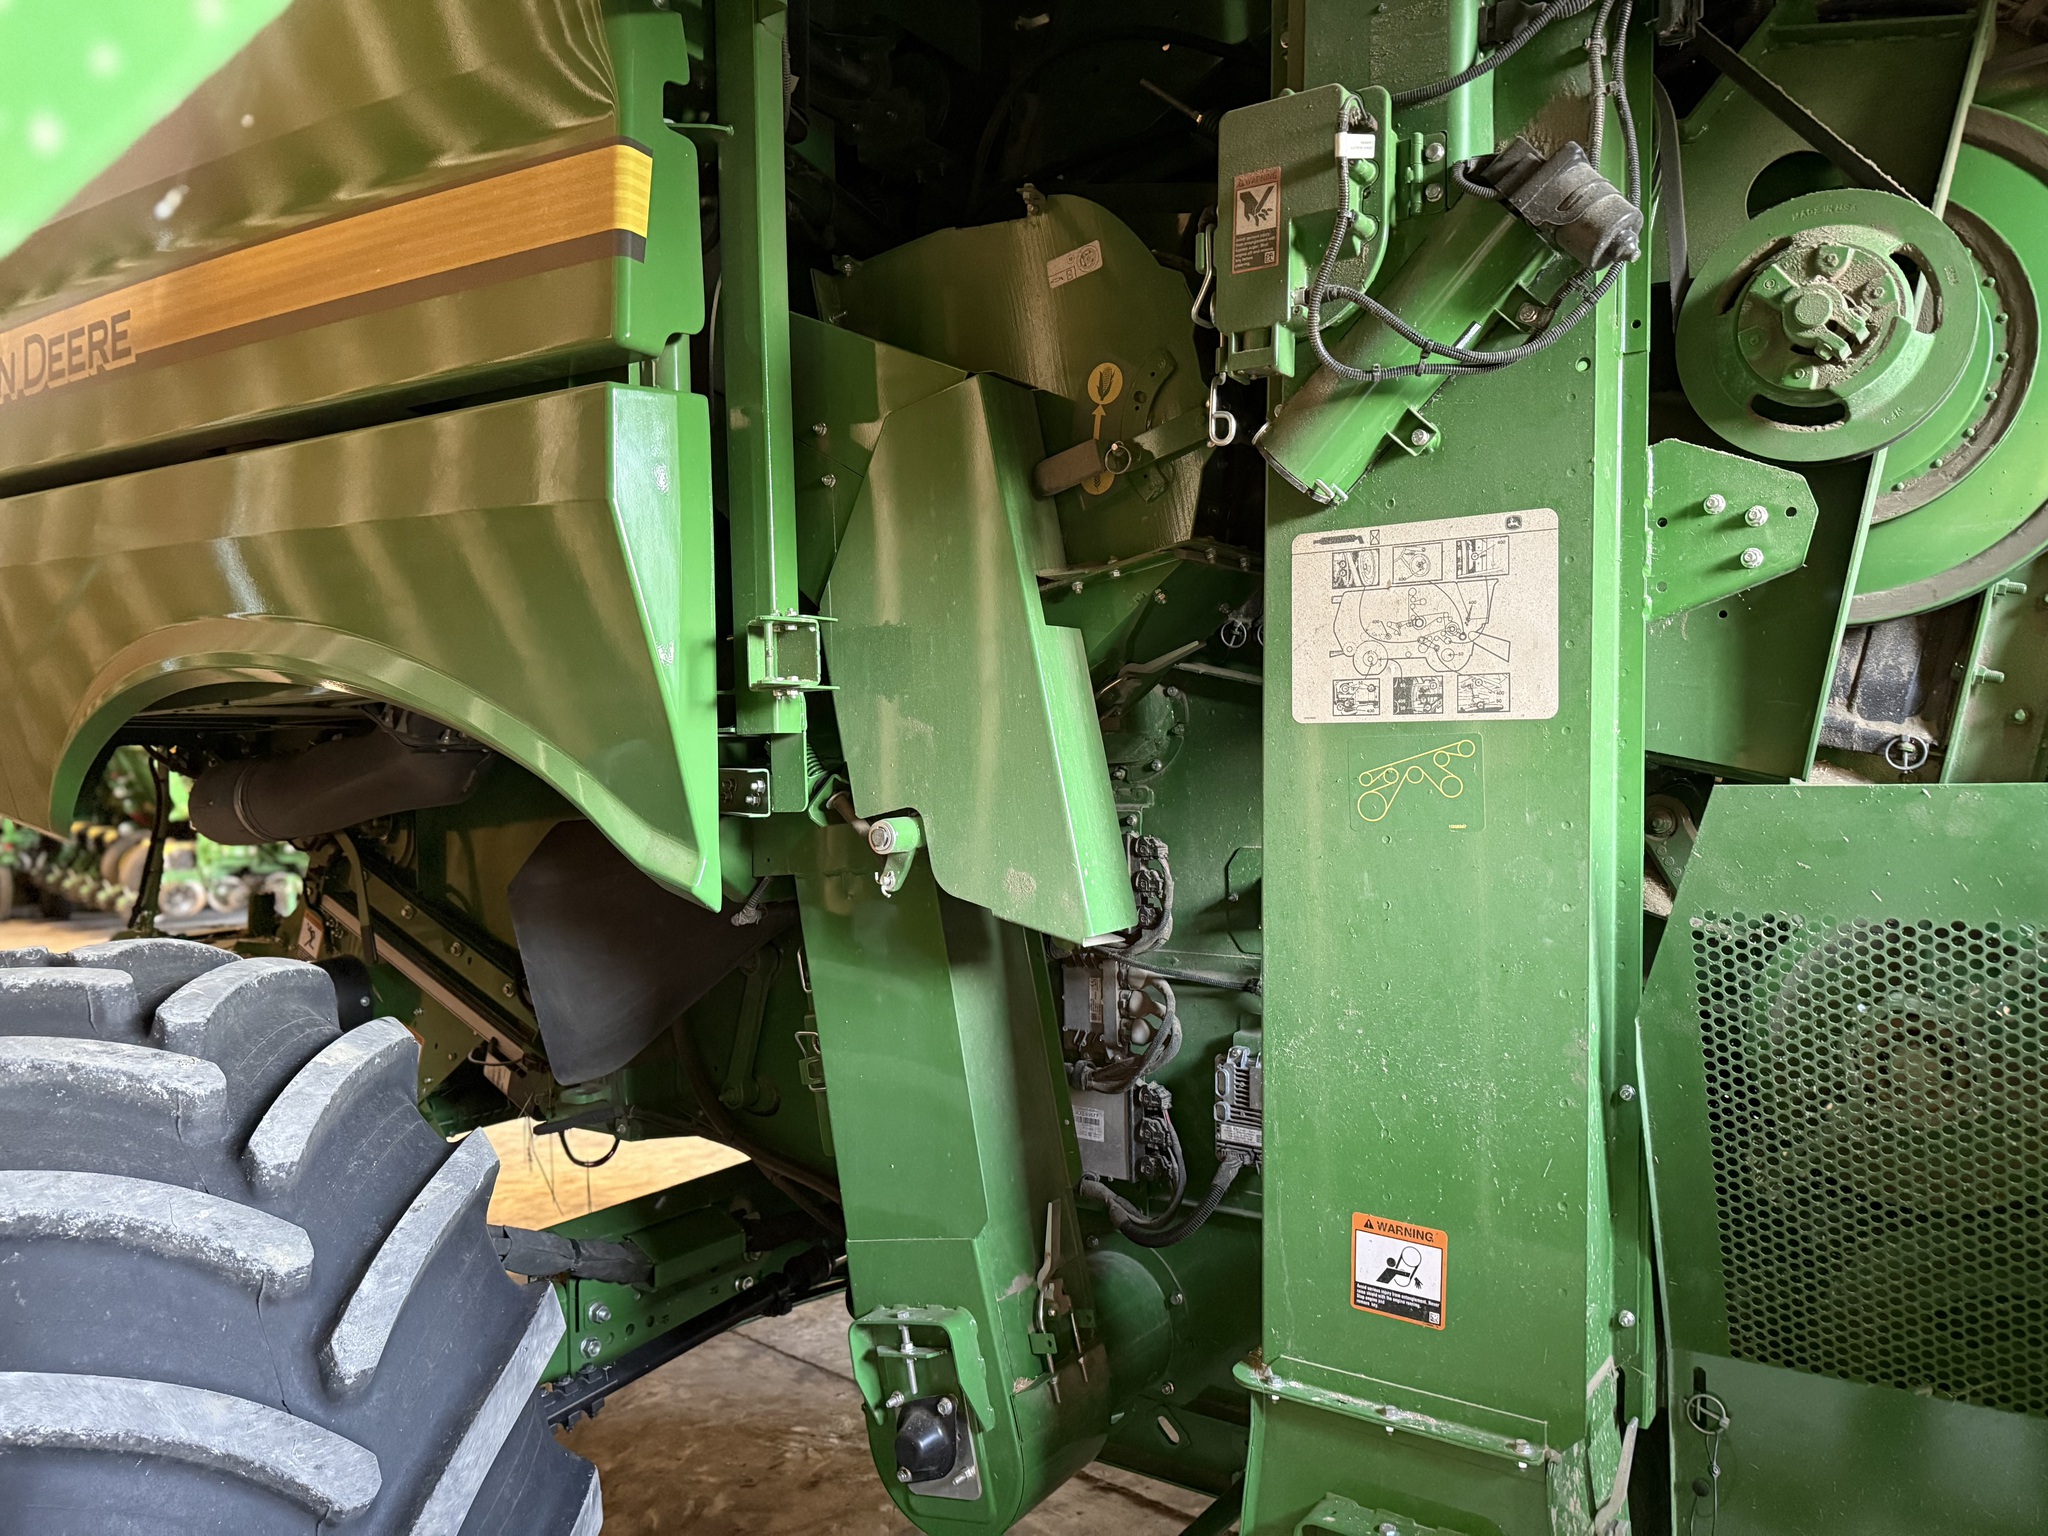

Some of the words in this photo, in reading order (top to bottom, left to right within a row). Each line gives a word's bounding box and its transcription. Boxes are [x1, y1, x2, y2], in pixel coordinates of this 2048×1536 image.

[1792, 208, 1819, 221] MADE
[1824, 204, 1834, 214] IN
[1836, 204, 1858, 212] USA
[24, 310, 131, 390] DEERE
[1377, 1221, 1434, 1242] WARNING
